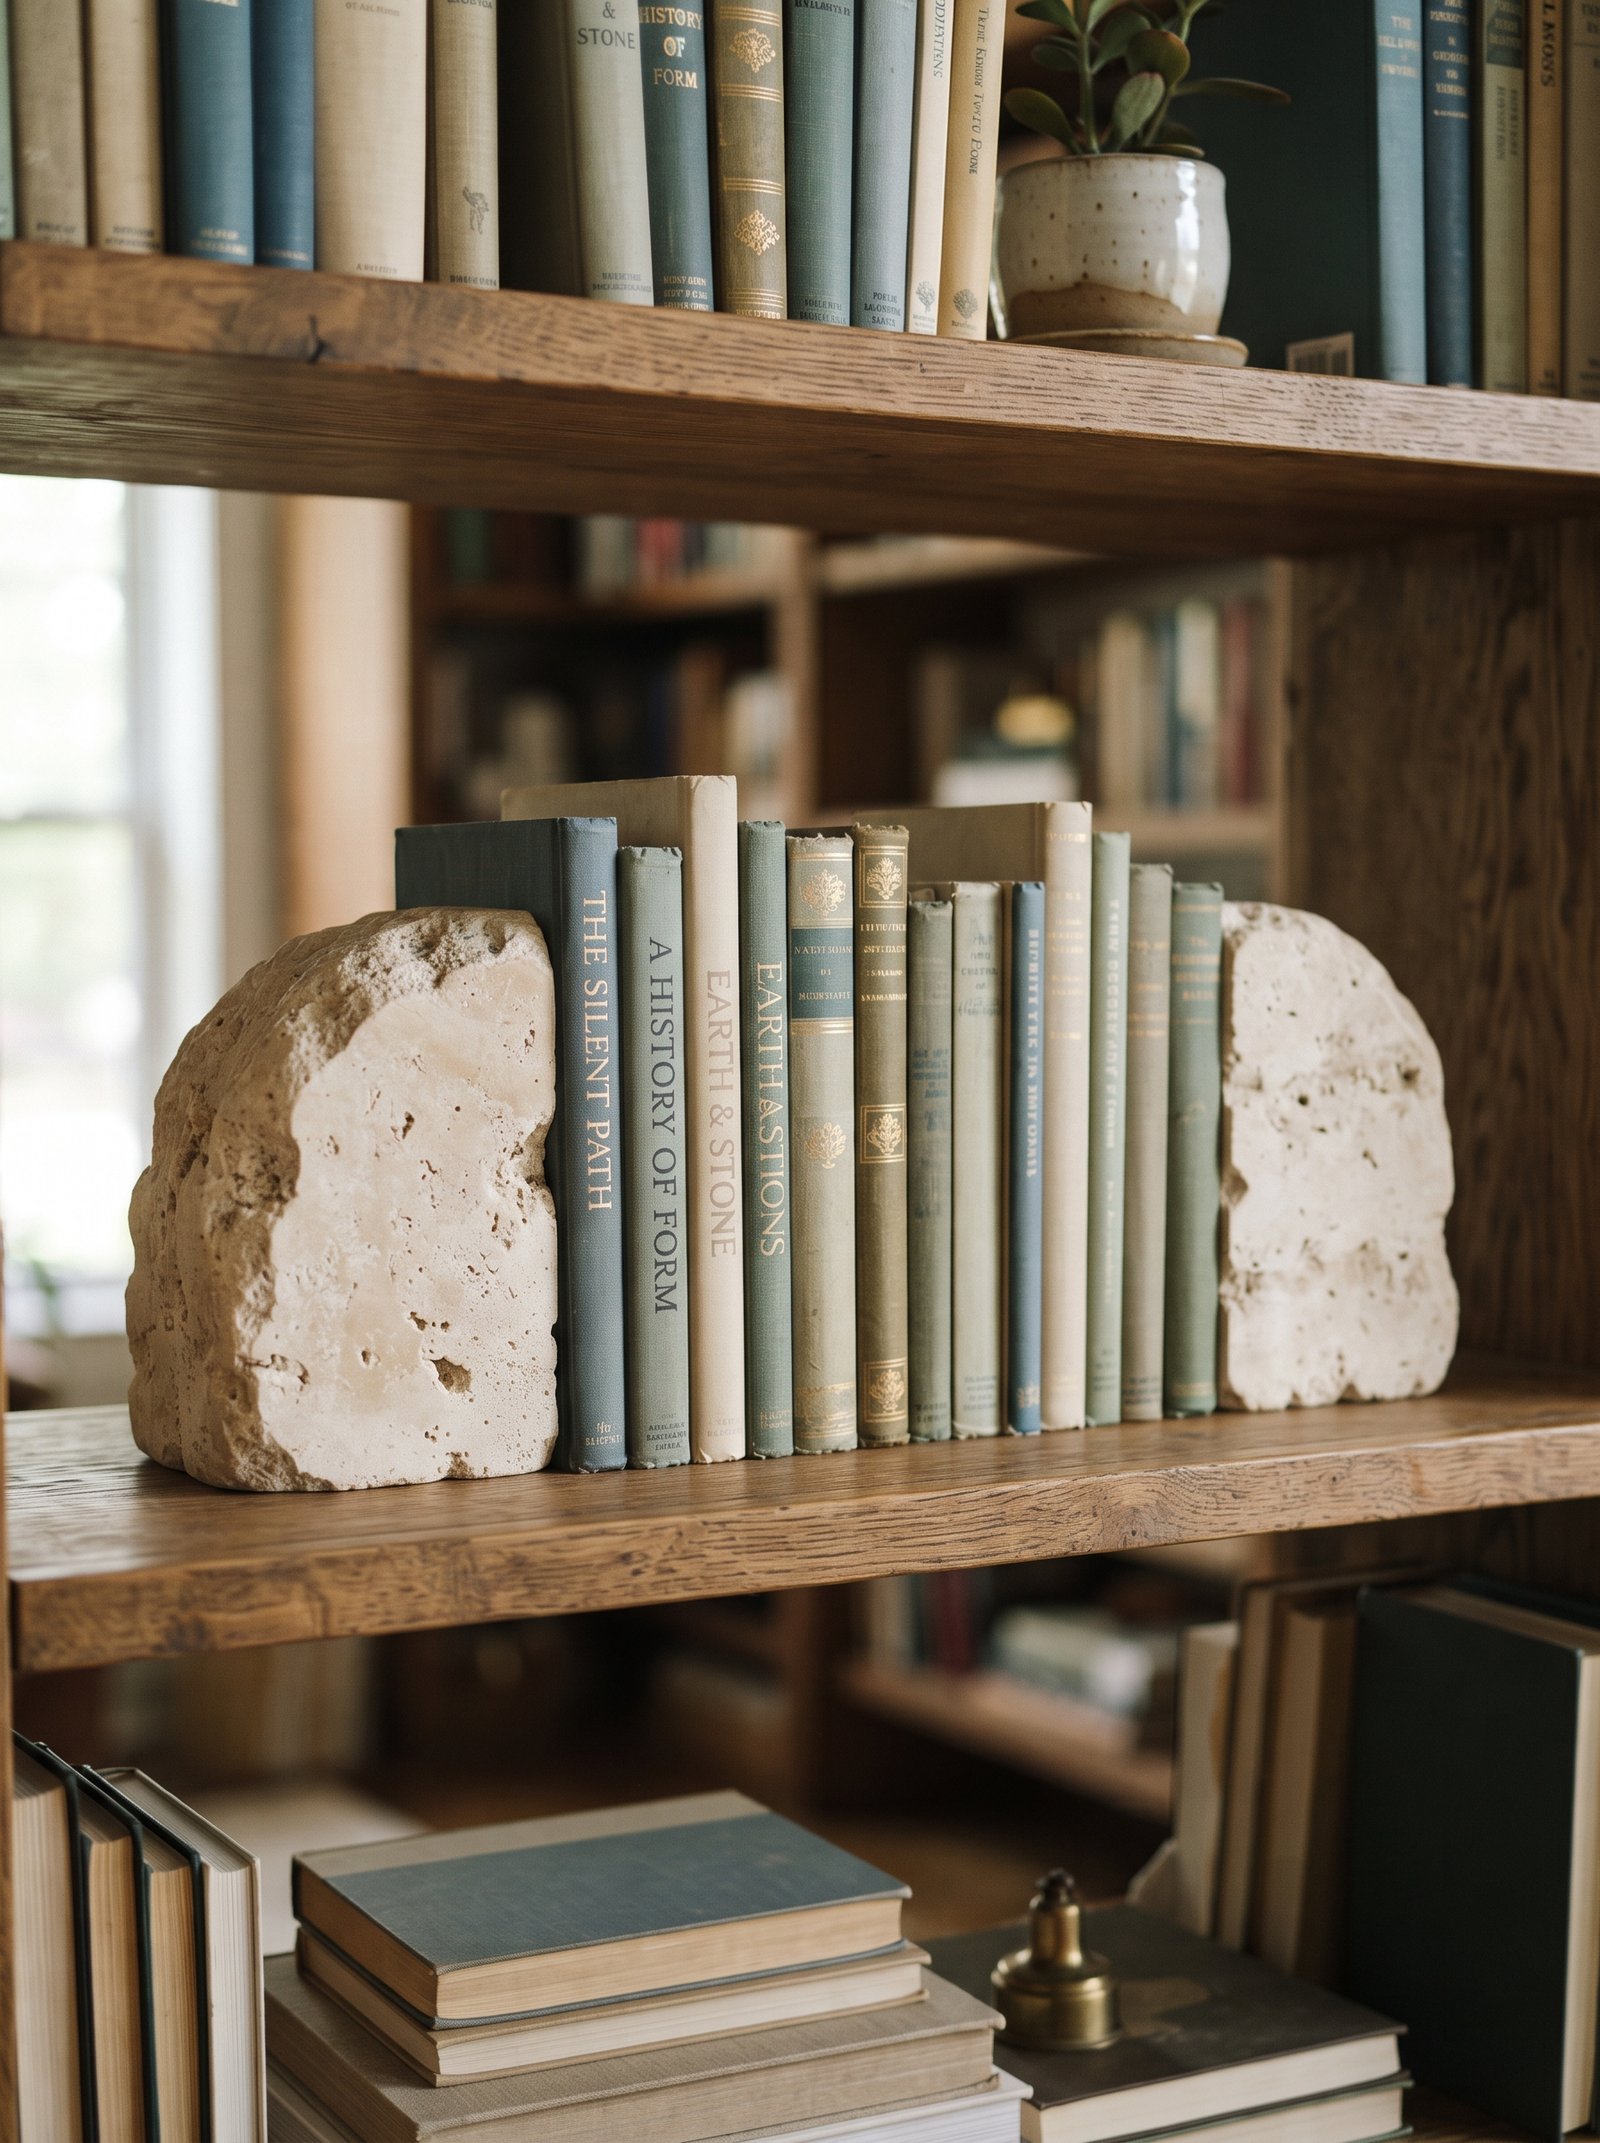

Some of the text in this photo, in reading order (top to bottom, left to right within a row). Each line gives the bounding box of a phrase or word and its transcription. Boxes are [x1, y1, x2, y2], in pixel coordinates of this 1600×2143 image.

[602, 1, 616, 19] &
[639, 6, 702, 30] HISTORY
[576, 27, 636, 50] STONE
[663, 35, 686, 58] OF
[653, 67, 698, 89] FORM
[583, 890, 613, 1211] THE SILENT PATH
[649, 937, 679, 1314] A HISTORY OF FORM
[706, 969, 738, 1259] EARTH & STONE
